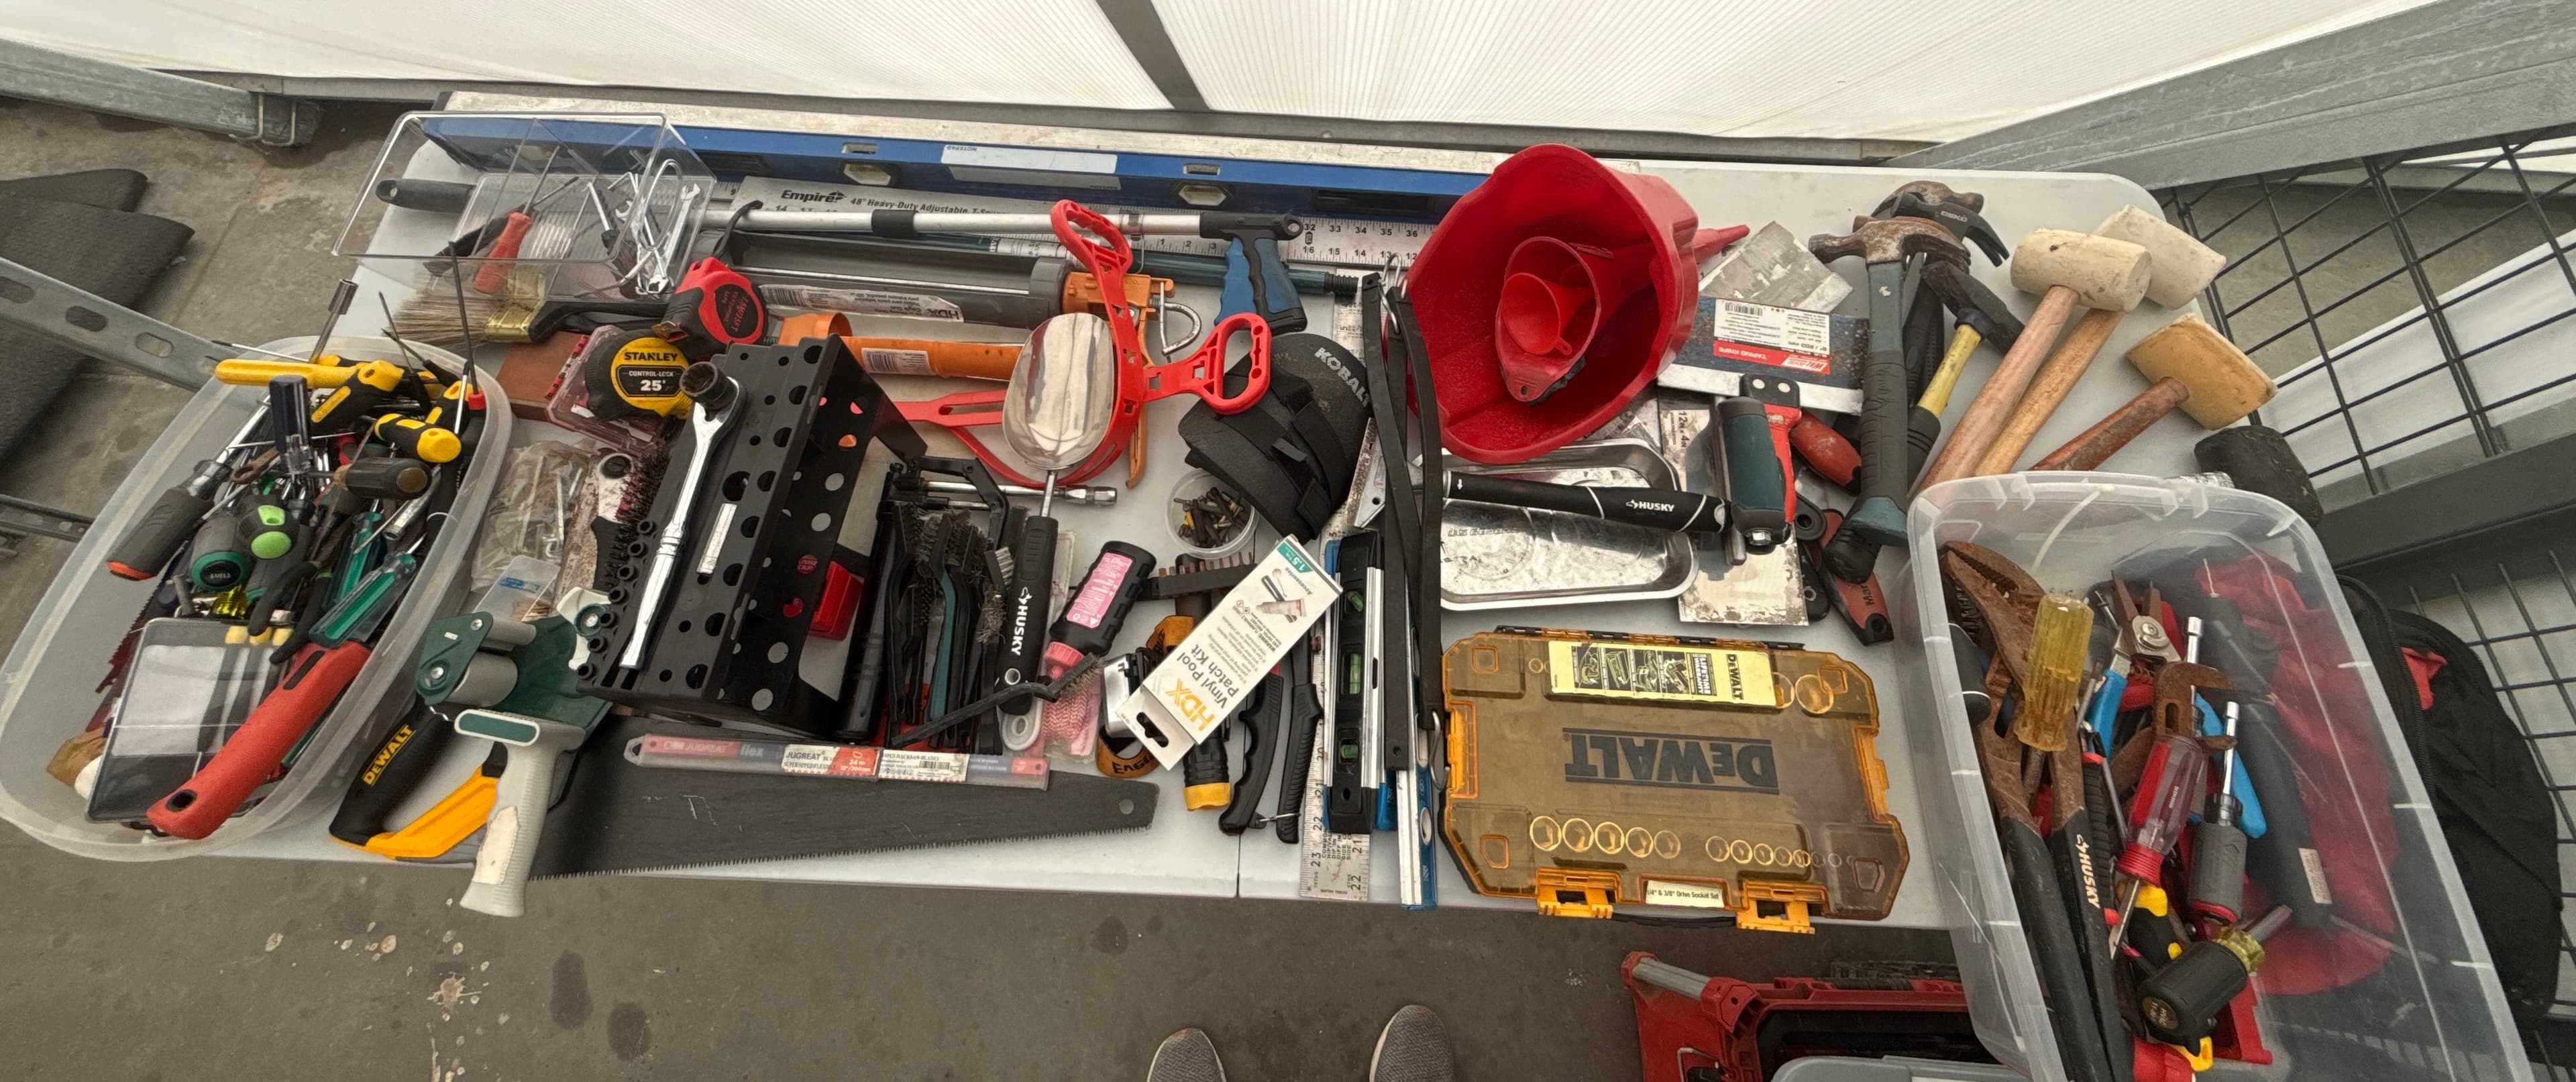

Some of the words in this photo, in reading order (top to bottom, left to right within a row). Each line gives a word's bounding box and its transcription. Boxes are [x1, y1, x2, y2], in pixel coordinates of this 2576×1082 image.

[782, 189, 836, 203] Empire
[867, 199, 919, 211] Heavy-Duty
[1304, 223, 1316, 231] 32
[1329, 225, 1342, 233] 33
[1354, 226, 1367, 234] 34
[1380, 228, 1393, 236] 35
[1354, 249, 1366, 257] 14
[624, 351, 678, 362] STANLEY
[1638, 502, 1675, 514] HUSKY
[1291, 555, 1307, 572] 1.5
[1283, 566, 1313, 597] Accessories
[1860, 584, 1876, 606] Mar
[1012, 605, 1028, 656] HUSKY
[1189, 643, 1210, 665] Kit
[1176, 651, 1205, 681] Pool
[1206, 661, 1240, 698] Patch
[1694, 657, 1703, 694] WARRANTY
[1699, 657, 1711, 694] LIFETIME
[1199, 675, 1230, 709] Vinyl
[1164, 677, 1216, 732] HDX
[739, 745, 765, 757] flex
[1112, 755, 1155, 773] EAGL
[1313, 816, 1323, 831] 22
[1352, 840, 1362, 854] 21
[1311, 851, 1322, 867] 23
[1350, 875, 1361, 891] 22
[2078, 849, 2100, 910] HUSKY
